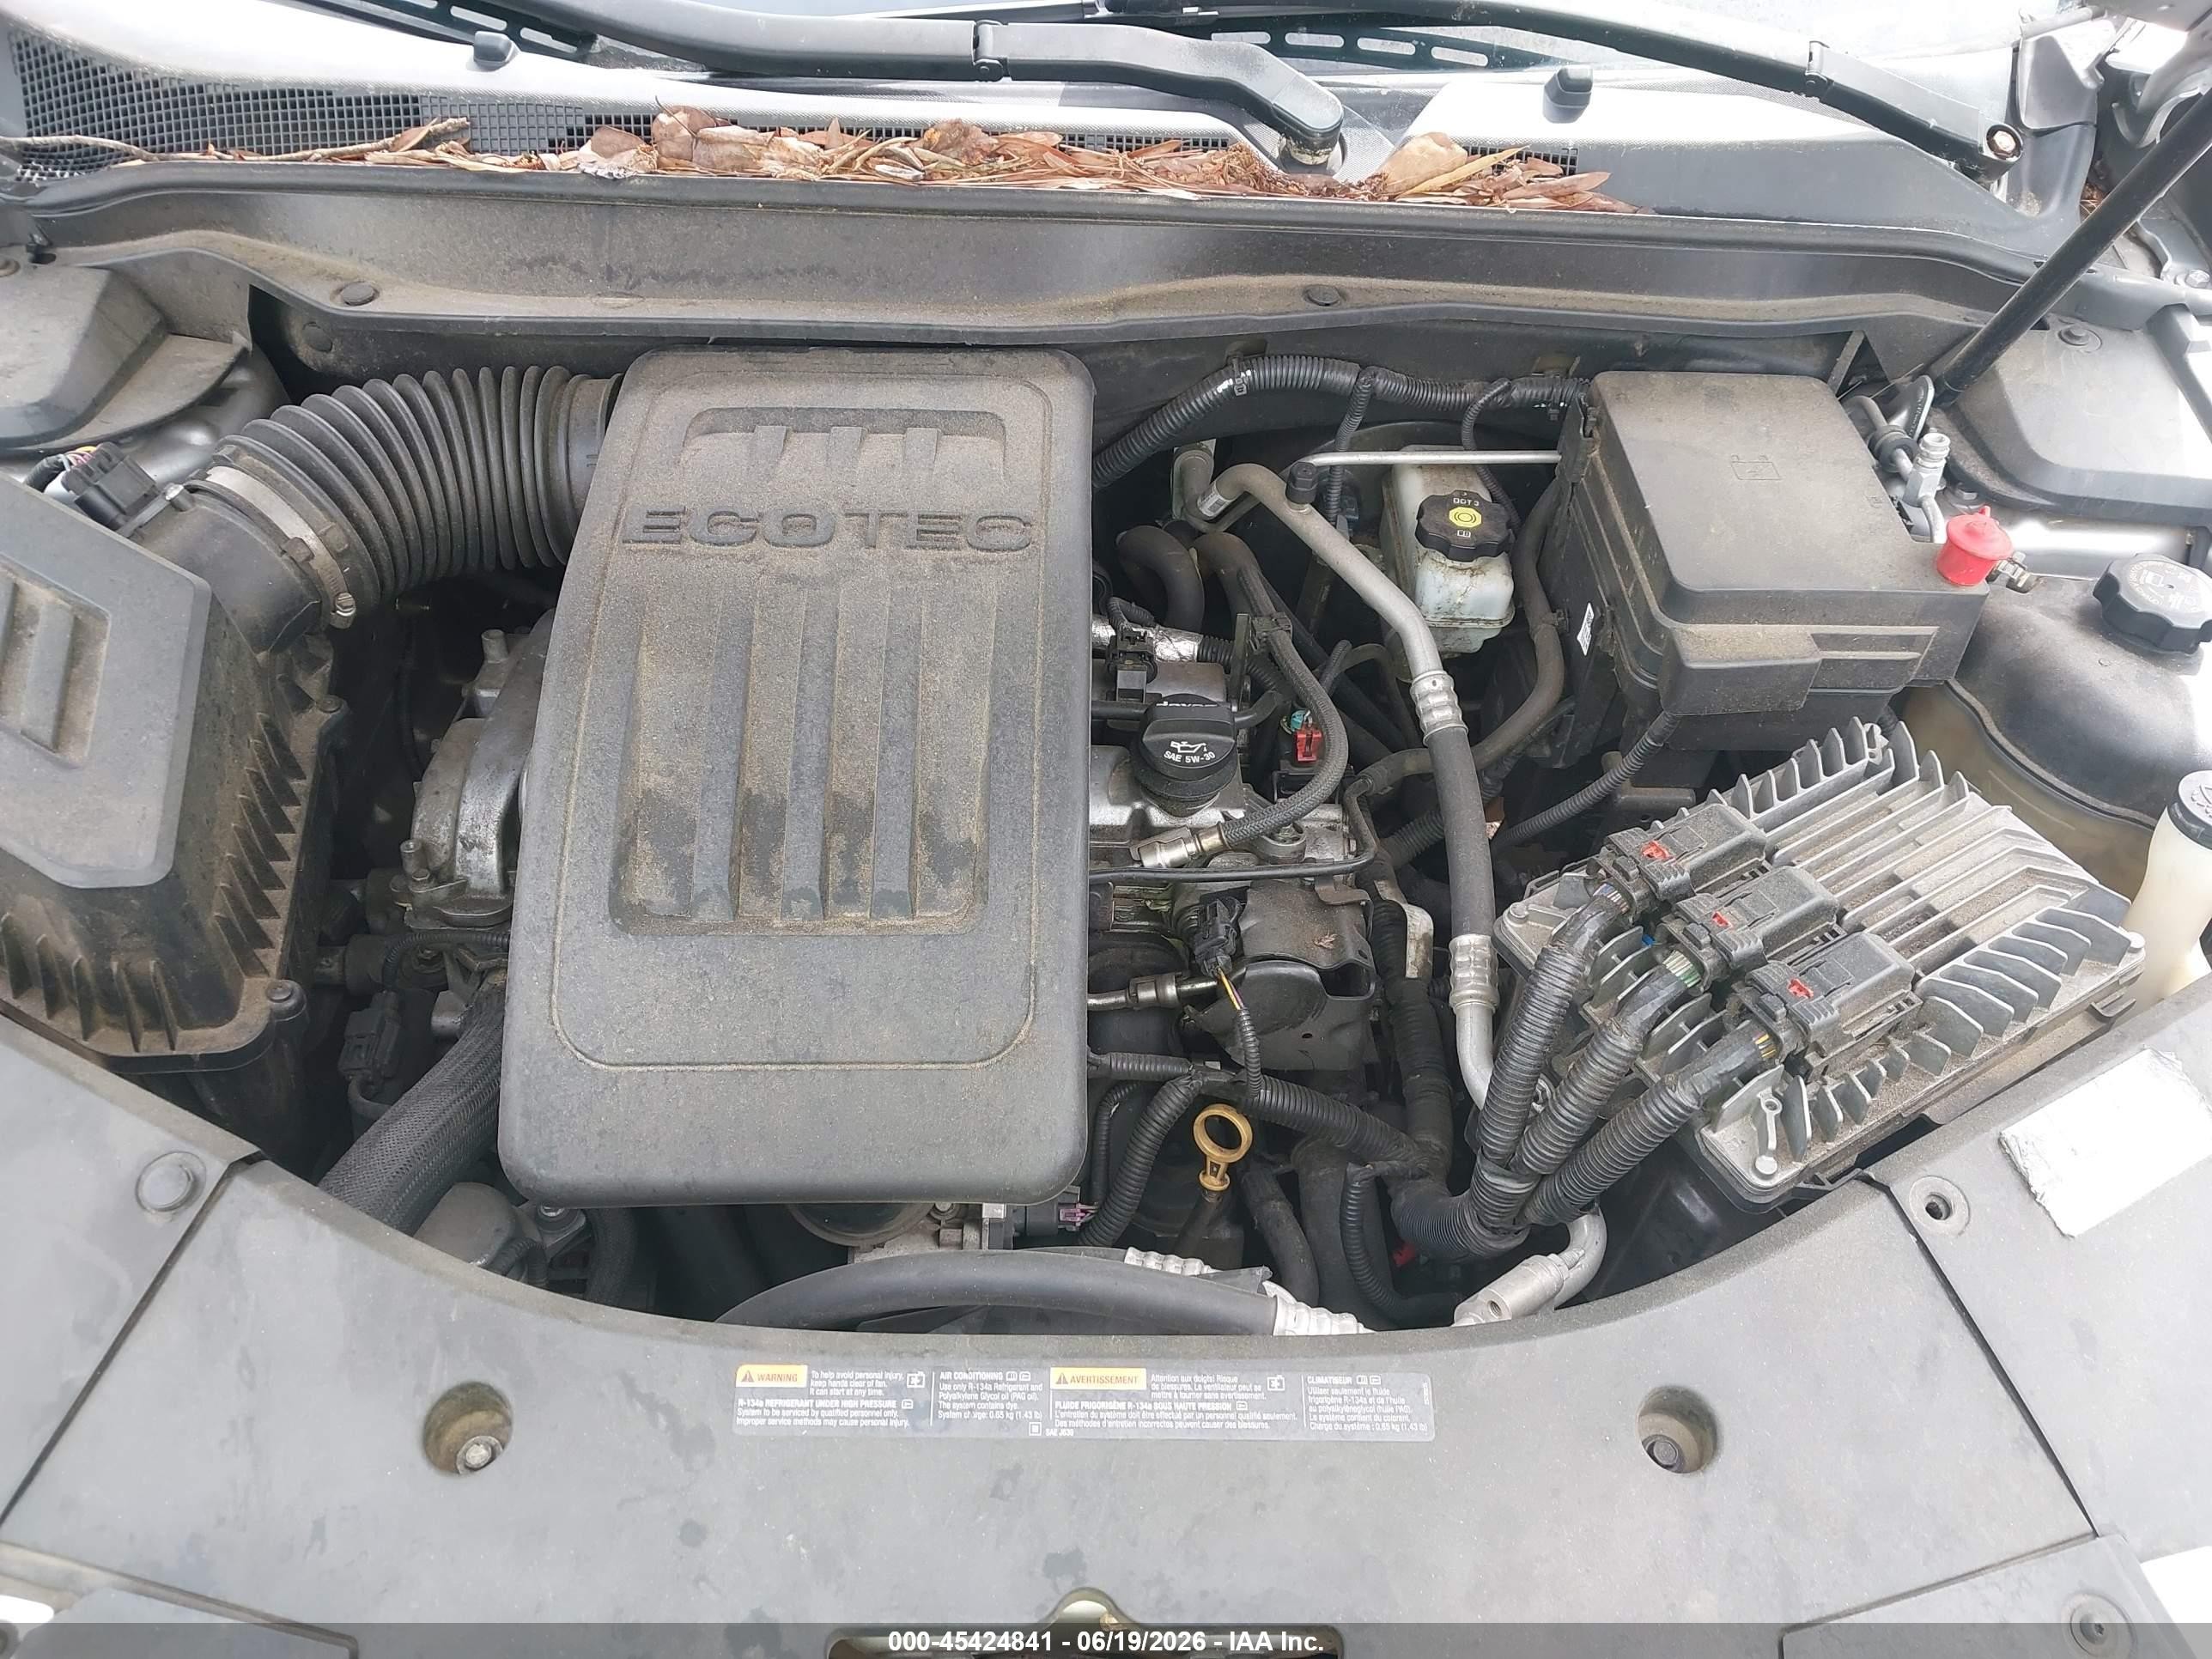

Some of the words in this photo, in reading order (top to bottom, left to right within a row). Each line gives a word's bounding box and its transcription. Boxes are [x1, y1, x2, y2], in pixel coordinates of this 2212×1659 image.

[622, 507, 1033, 552] ECOTEC
[1164, 750, 1182, 763] SAE
[1185, 751, 1216, 763] 5W-30
[757, 1373, 798, 1382] WARNING
[811, 1370, 819, 1379] To
[820, 1370, 836, 1381] help
[836, 1370, 854, 1379] avoid
[855, 1370, 883, 1381] personal
[940, 1371, 952, 1380] AIR
[953, 1371, 1003, 1381] CONDITIONING
[1070, 1375, 1139, 1384] AVERTISSEMENT
[1152, 1374, 1180, 1382] Attention
[1216, 1375, 1238, 1384] Risque
[1307, 1376, 1352, 1384] CLIMATISEUR
[939, 1382, 951, 1391] Use
[953, 1382, 967, 1391] only
[968, 1382, 993, 1391] R-134a
[994, 1382, 1029, 1392] Refrigerant
[765, 1399, 813, 1408] REFRIGERANT
[815, 1399, 840, 1408] UNDER
[842, 1400, 859, 1408] HIGH
[860, 1400, 896, 1408] PRESSURE
[1054, 1401, 1079, 1409] FLUIDE
[1153, 1401, 1172, 1410] SOUS
[1174, 1401, 1196, 1411] HAUTE
[1198, 1402, 1231, 1411] PRESSION
[738, 1408, 762, 1418] System
[772, 1408, 781, 1417] be
[781, 1408, 809, 1417] serviced
[811, 1409, 819, 1419] by
[821, 1409, 848, 1419] qualified
[850, 1409, 882, 1419] personnel
[884, 1409, 899, 1419] only.
[737, 1417, 766, 1426] Improper
[860, 1419, 888, 1427] personal
